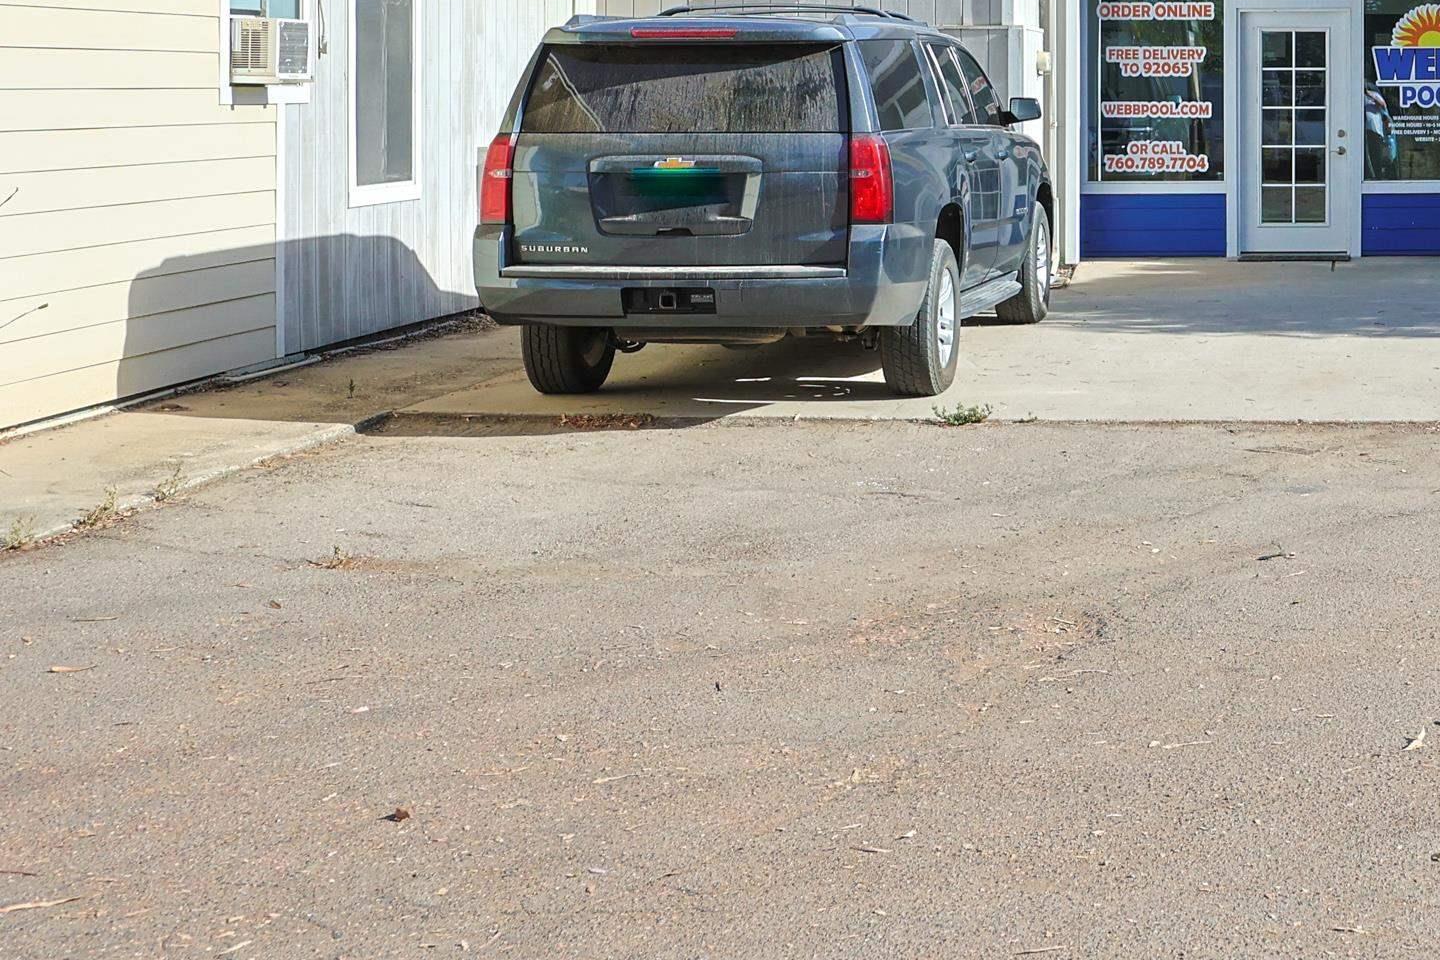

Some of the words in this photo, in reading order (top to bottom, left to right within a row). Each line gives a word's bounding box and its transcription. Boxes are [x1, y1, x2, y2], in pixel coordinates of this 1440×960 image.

[1100, 4, 1151, 18] ORDER
[1155, 4, 1212, 18] ONLINE
[1108, 48, 1139, 60] FREE
[1143, 48, 1204, 60] DELIVERY
[1122, 62, 1139, 74] TO
[1143, 62, 1189, 74] 92065
[1104, 104, 1210, 115] WEBBPOOL.COM
[1130, 144, 1148, 155] OR
[1152, 144, 1184, 155] CALL
[1106, 157, 1207, 170] 760.789.7704
[520, 245, 588, 253] SUBURBAN
